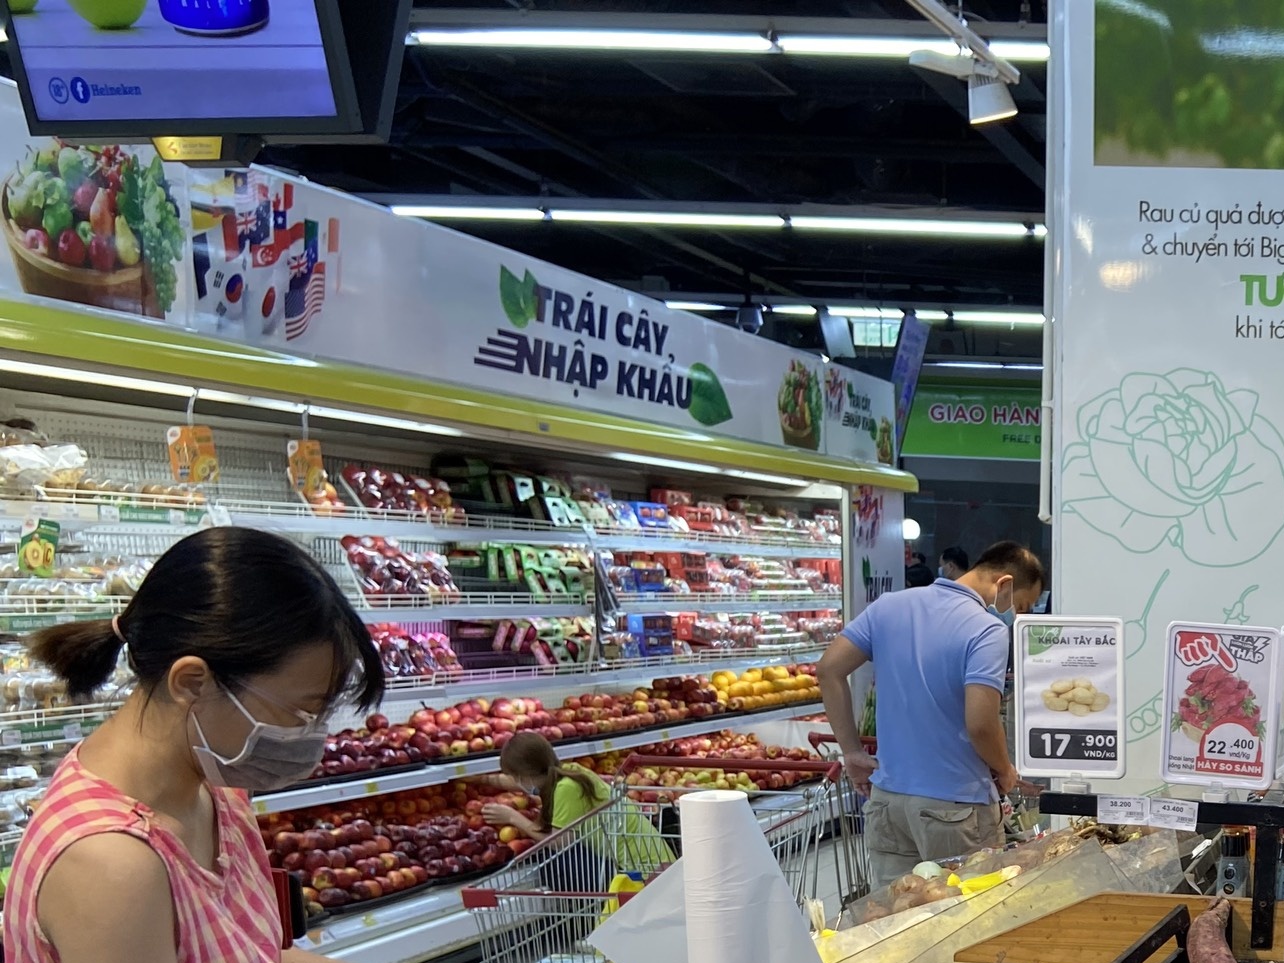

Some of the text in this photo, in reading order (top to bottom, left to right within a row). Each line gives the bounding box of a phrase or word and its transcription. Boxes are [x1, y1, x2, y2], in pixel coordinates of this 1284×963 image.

[91, 84, 142, 97] Heineken
[1139, 200, 1174, 223] Rau
[1179, 202, 1201, 223] củ
[1206, 203, 1242, 230] quả
[1141, 233, 1158, 256] &
[1162, 232, 1228, 263] chuyển
[1234, 237, 1254, 258] tới
[534, 284, 669, 356] TRÁI CÂY
[1235, 315, 1263, 339] khi
[510, 335, 609, 398] NHẬP
[929, 401, 1041, 425] GIAO HÀN
[1002, 433, 1031, 444] FREE
[1038, 636, 1070, 645] KHOAI
[1073, 635, 1093, 645] TÂY
[1040, 732, 1071, 757] 17
[1083, 750, 1116, 759] VND/KG
[1207, 740, 1227, 754] 22
[1219, 763, 1233, 771] SO
[1234, 762, 1262, 774] SÁNH
